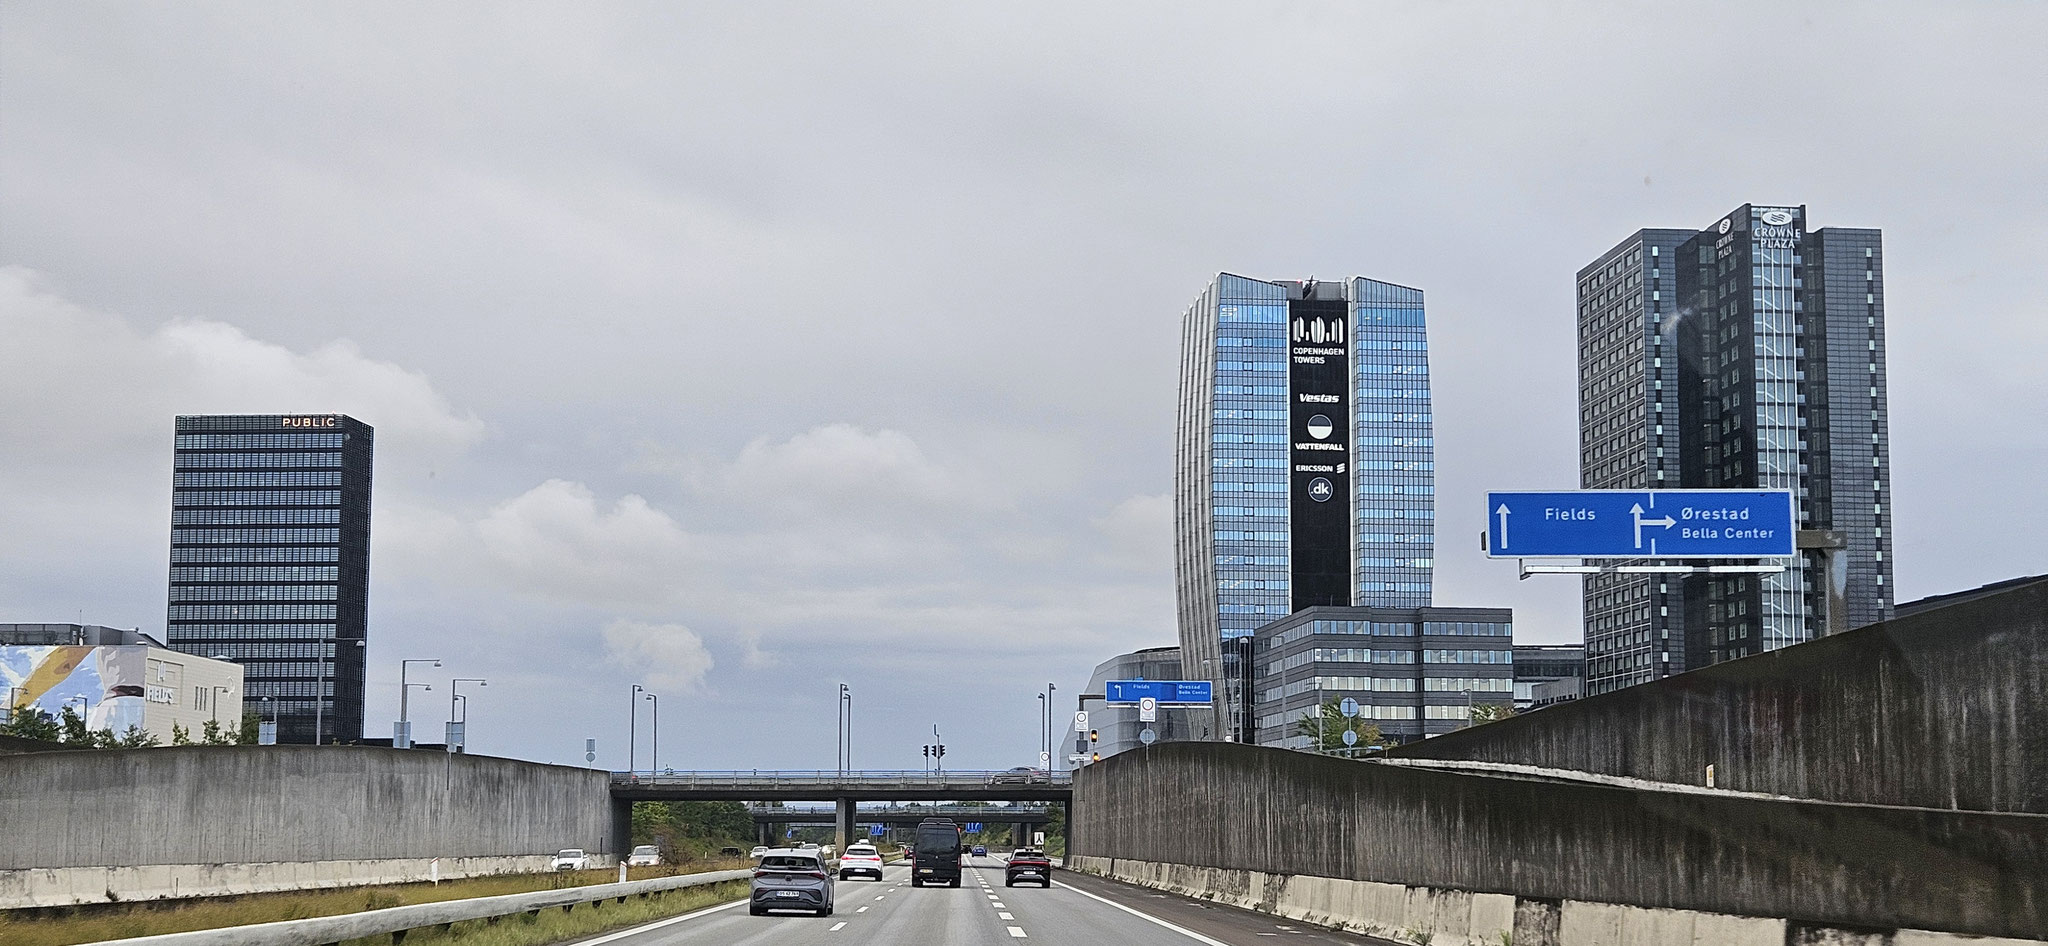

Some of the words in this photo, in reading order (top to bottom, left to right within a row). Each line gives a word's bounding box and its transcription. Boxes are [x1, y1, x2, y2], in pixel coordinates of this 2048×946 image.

[1754, 228, 1801, 238] CROWNE
[1761, 239, 1795, 248] PLAZA
[1718, 245, 1733, 259] PLAZA
[1293, 347, 1345, 355] COPENHAGEN
[1293, 356, 1326, 364] TOWERS
[1299, 393, 1340, 403] Vestas
[282, 417, 335, 427] PUBLIC
[1295, 443, 1345, 451] VATTENFALL
[1296, 464, 1333, 472] ERICSSON
[1310, 482, 1330, 495] .dk
[1545, 507, 1596, 521] Fields
[1681, 507, 1750, 520] Ørestad
[1682, 527, 1718, 539] Bella
[1725, 527, 1774, 539] Center
